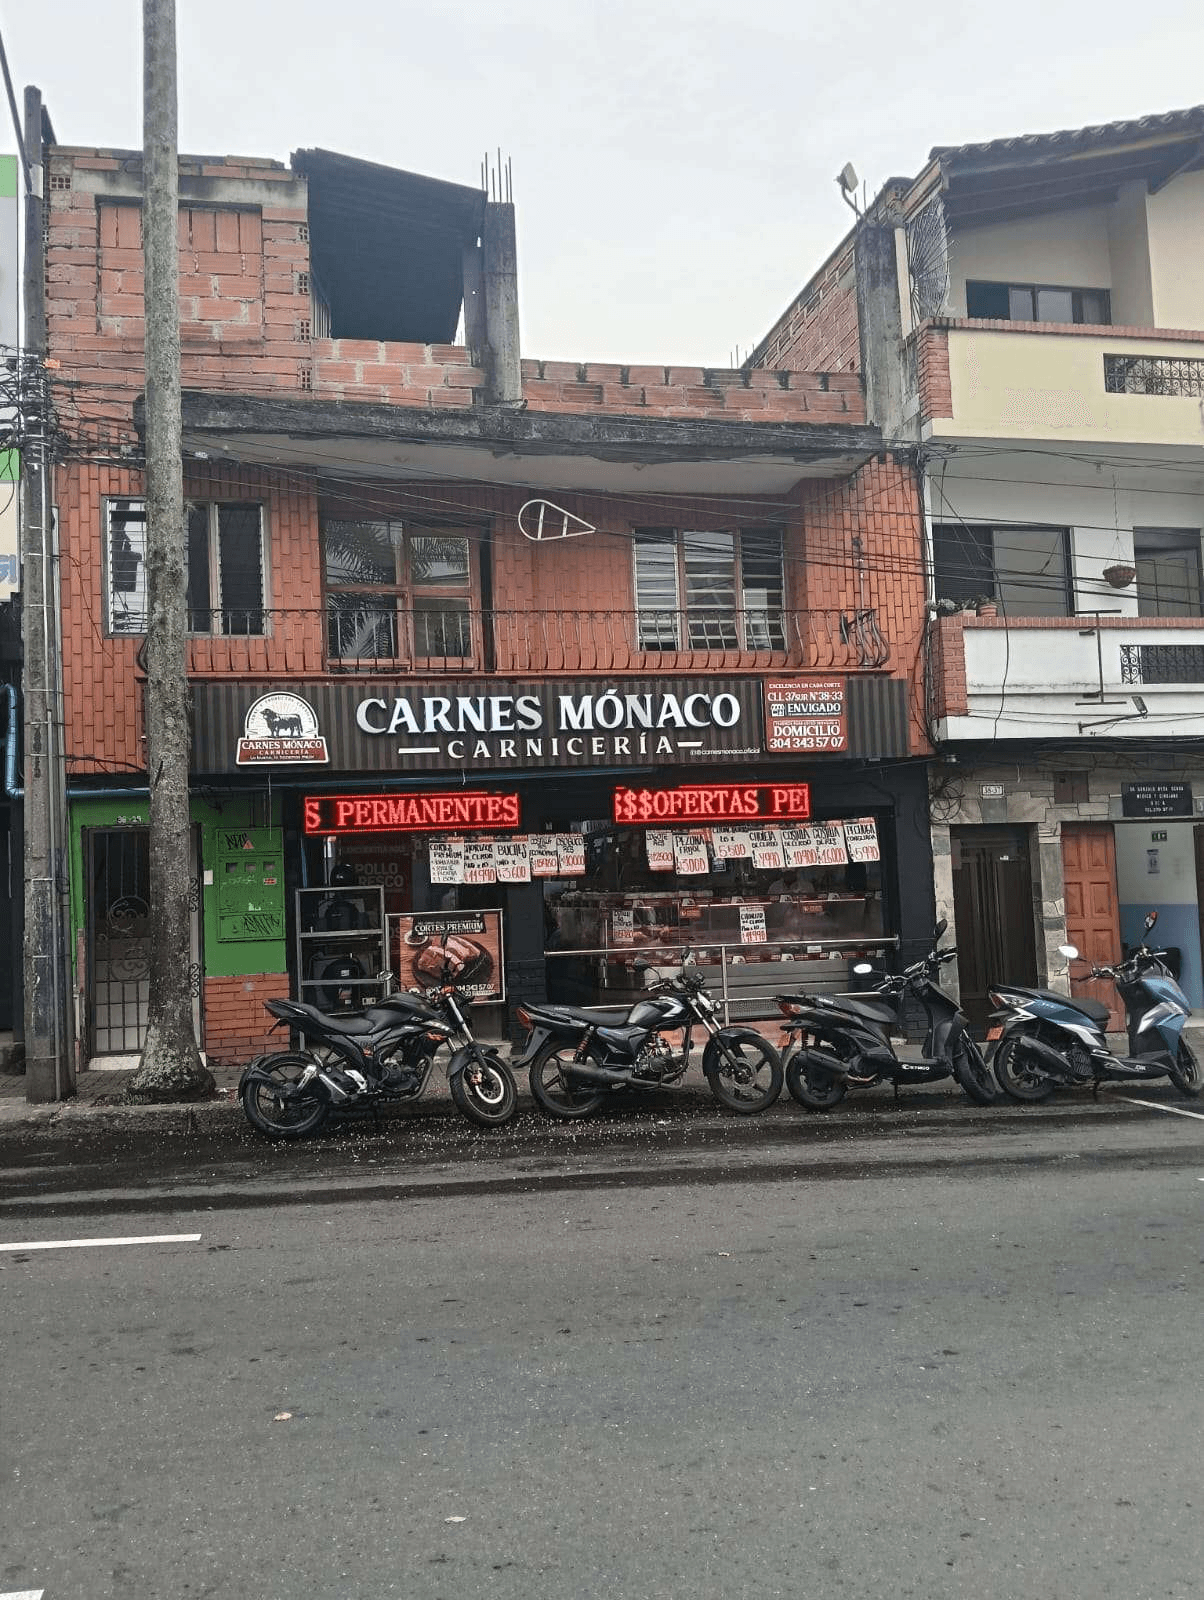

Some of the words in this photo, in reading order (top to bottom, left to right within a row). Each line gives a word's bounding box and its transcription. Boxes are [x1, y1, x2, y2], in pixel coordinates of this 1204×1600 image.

[818, 691, 843, 701] 38-33
[356, 695, 543, 735] CARNES
[559, 688, 741, 731] MÓNACO
[787, 702, 841, 713] ENVIGADO
[773, 725, 841, 737] DOMICILIO
[241, 740, 281, 750] CARNES
[447, 731, 673, 759] CARNICERÍA
[769, 738, 791, 749] 304
[792, 738, 814, 748] 343
[815, 737, 830, 748] 57
[830, 736, 845, 748] 07
[259, 748, 310, 756] CARNICERÍA
[772, 788, 809, 813] PE
[305, 801, 320, 828] S
[336, 795, 519, 827] PERMANENTES
[354, 862, 399, 875] POLLO
[358, 874, 404, 888] RESCO
[414, 924, 446, 932] CORTES
[447, 921, 484, 931] PREMIUM
